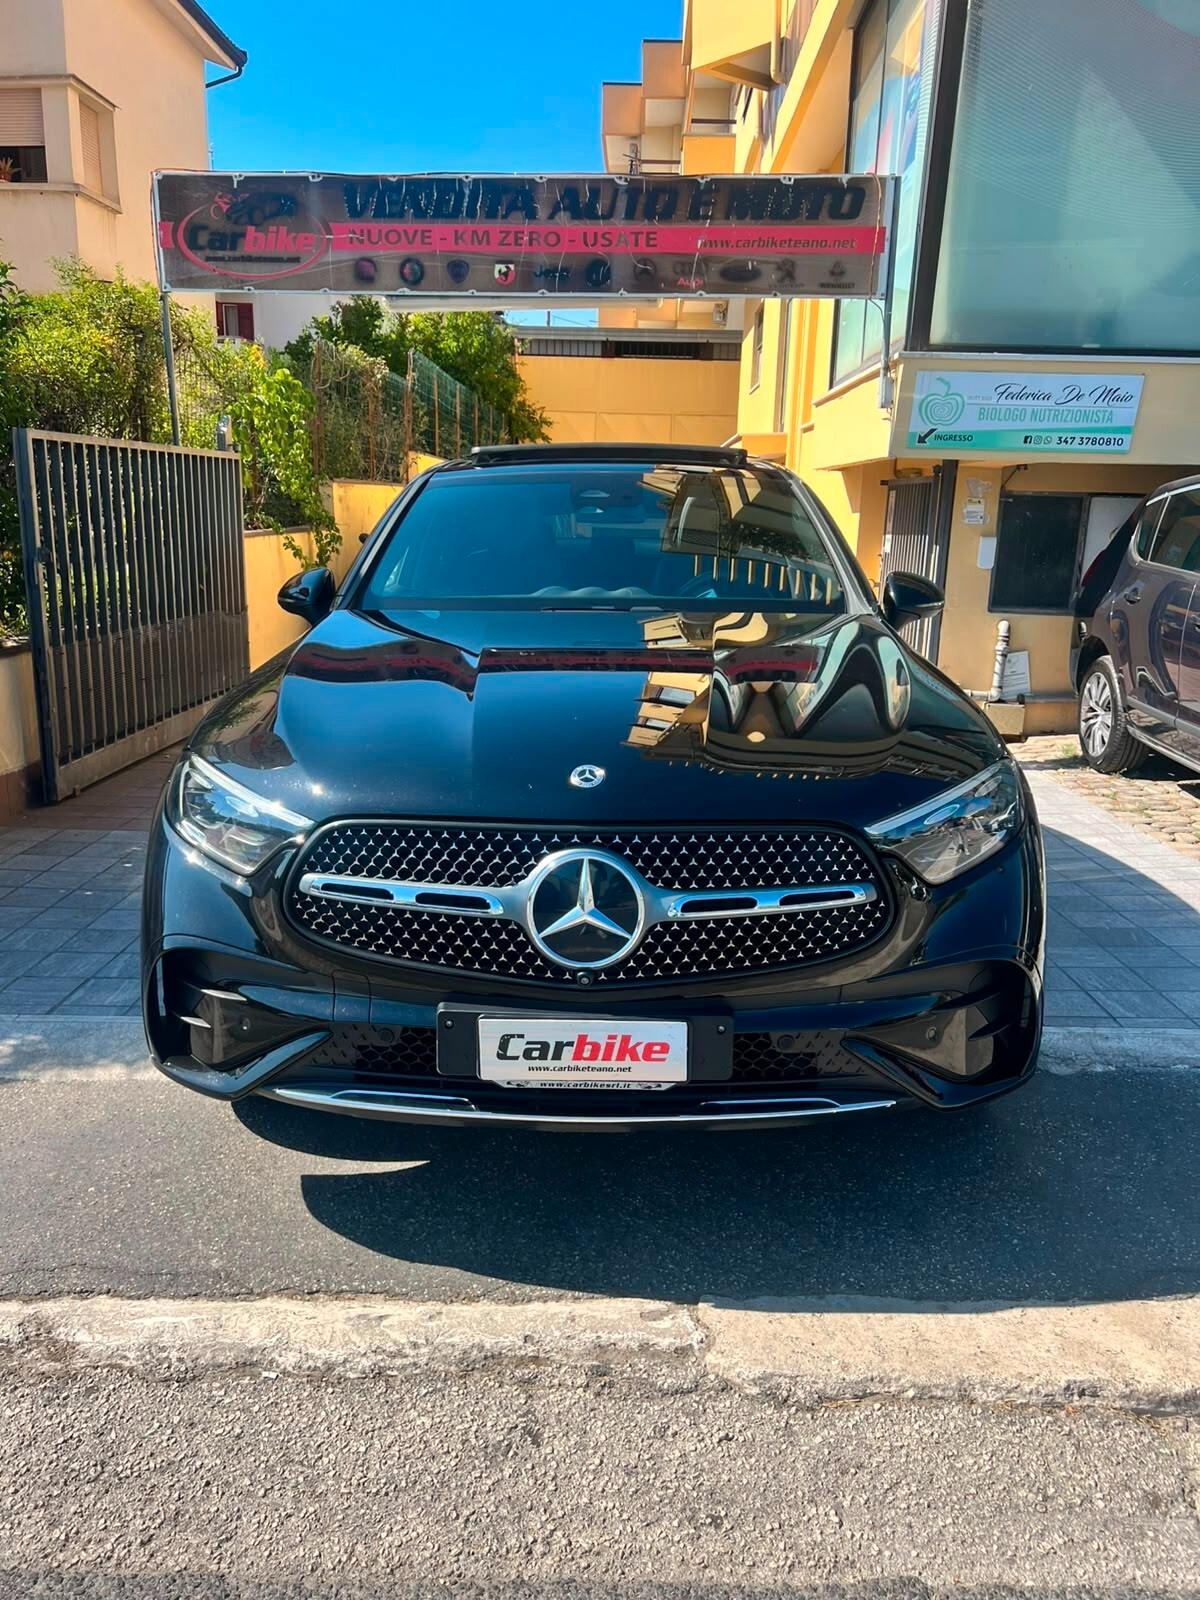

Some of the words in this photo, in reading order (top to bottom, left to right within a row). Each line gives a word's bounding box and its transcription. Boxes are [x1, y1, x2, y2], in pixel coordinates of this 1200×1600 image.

[548, 187, 679, 220] AUTO
[687, 183, 718, 220] E
[725, 184, 866, 220] MOTO
[187, 224, 317, 252] Carbike
[349, 228, 433, 246] NUOVE
[454, 230, 491, 246] KM
[498, 231, 561, 247] ZERO
[583, 231, 658, 248] USATE
[699, 236, 856, 249] www.carbiketeano.net
[994, 382, 1053, 403] Federica
[1054, 384, 1085, 406] De
[1088, 384, 1135, 407] Maio
[978, 406, 1027, 422] BIOLOGO
[1030, 408, 1114, 424] NUTRIZIONISTA
[933, 434, 974, 443] INGRESSO
[1056, 436, 1075, 446] 347
[1078, 436, 1124, 447] 3780810
[496, 1033, 671, 1063] Carbike
[527, 1064, 633, 1074] www.carbiketeano.net
[540, 1080, 632, 1090] www.carbikesrl.it
